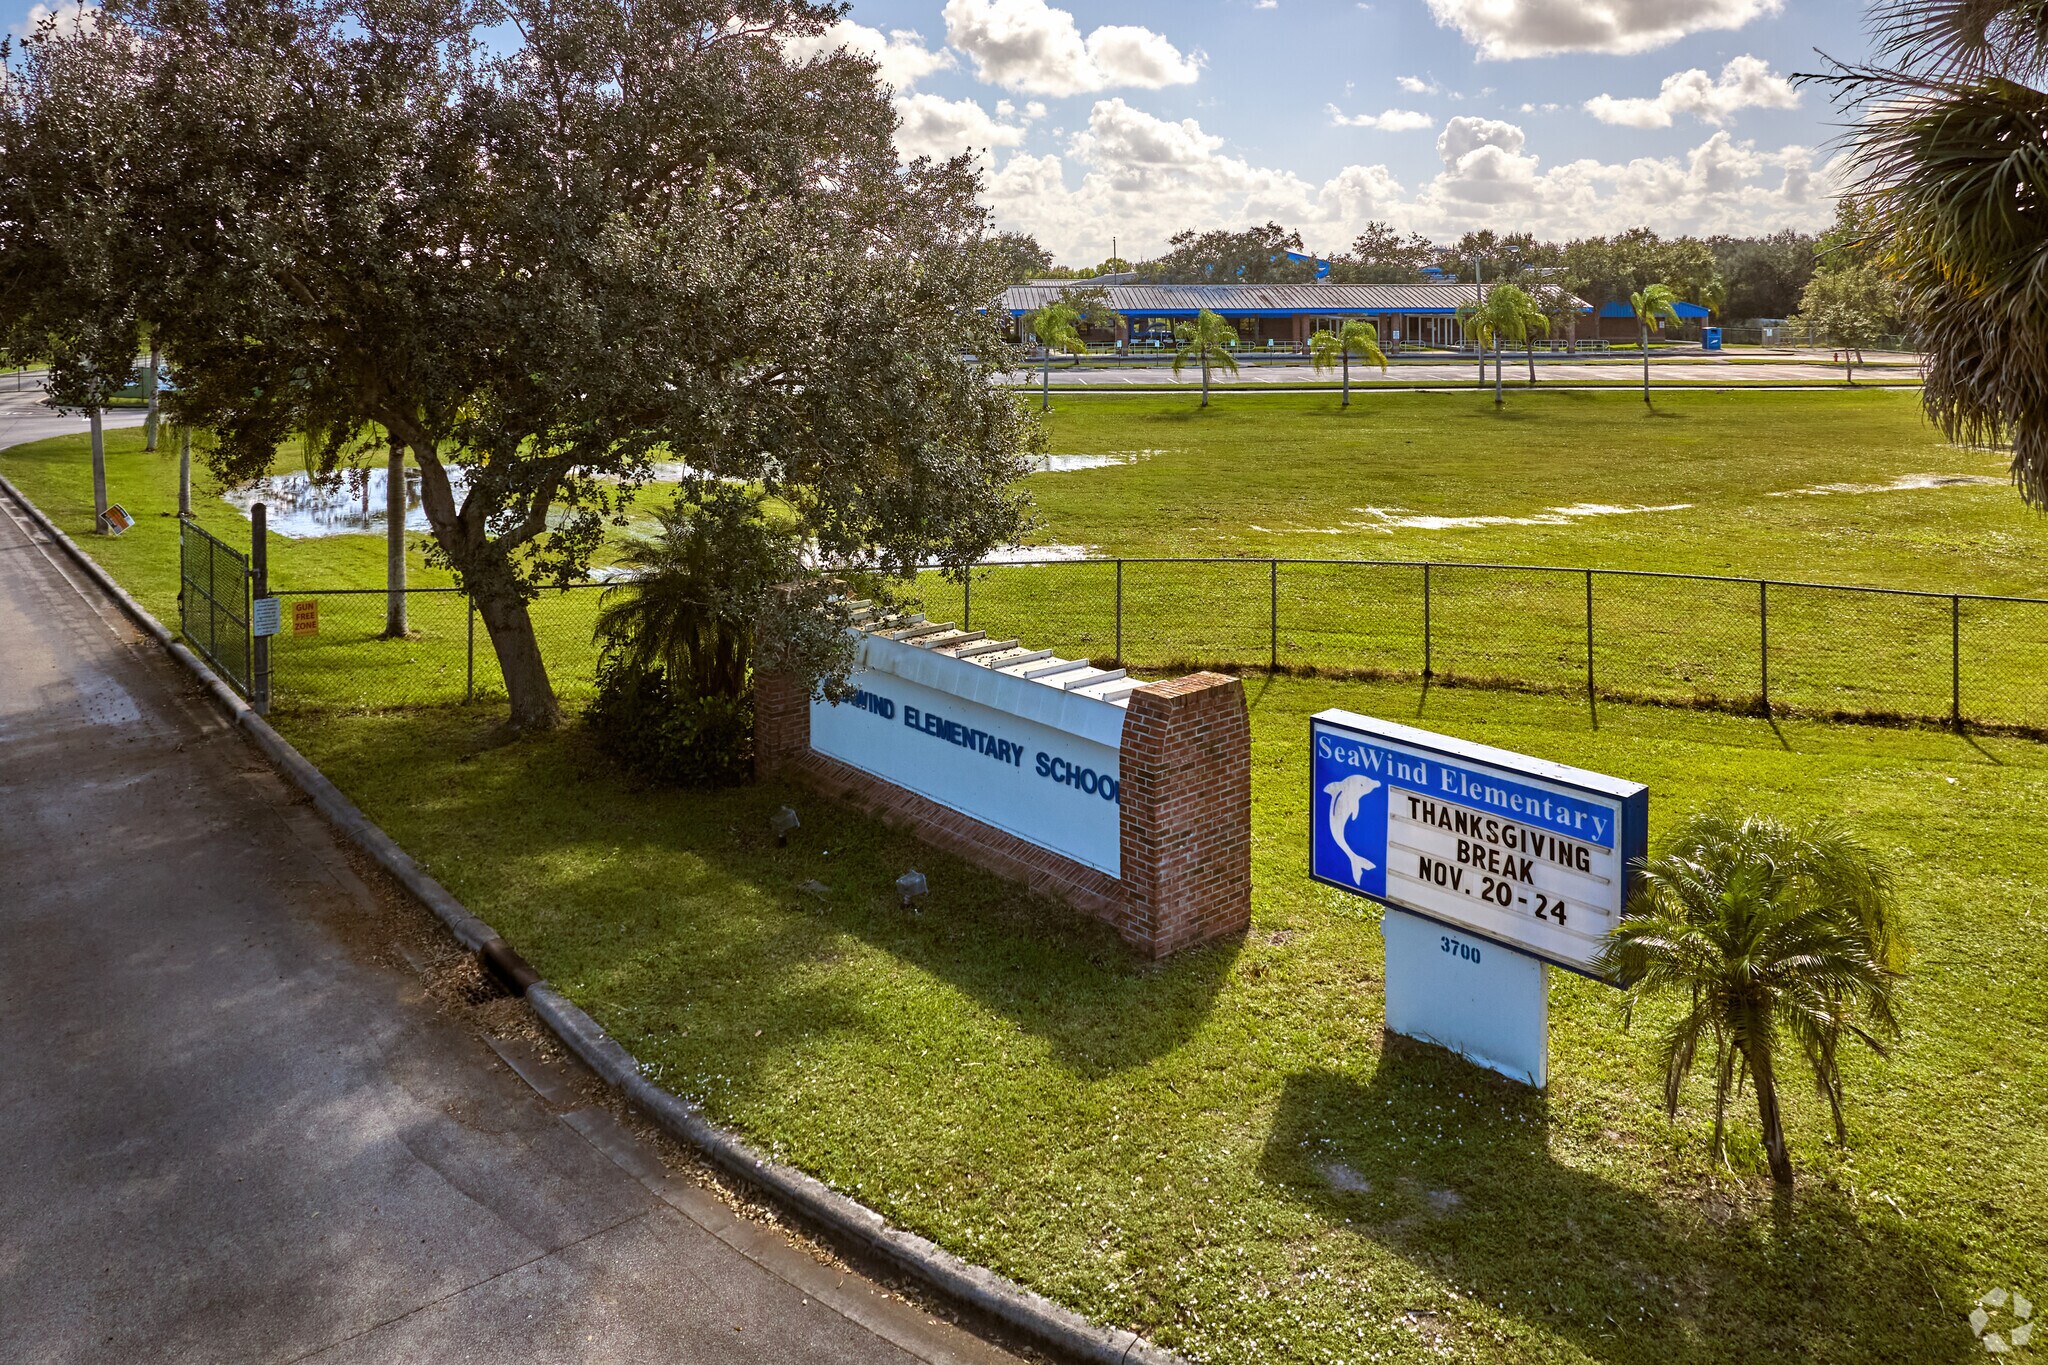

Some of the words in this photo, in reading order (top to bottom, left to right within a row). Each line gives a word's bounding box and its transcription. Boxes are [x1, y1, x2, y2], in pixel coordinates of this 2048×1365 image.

[295, 621, 317, 630] ZONE
[296, 603, 314, 611] GUN
[296, 612, 315, 620] FREE
[825, 678, 895, 720] WIND
[904, 705, 1024, 767] ELEMENTARY
[1318, 736, 1428, 785] SeaWind
[1440, 768, 1608, 842] Elementary
[1408, 796, 1591, 873] THANKSGIVING
[1419, 857, 1471, 895] NOV.
[1457, 839, 1534, 885] BREAK
[1440, 936, 1481, 965] 3700
